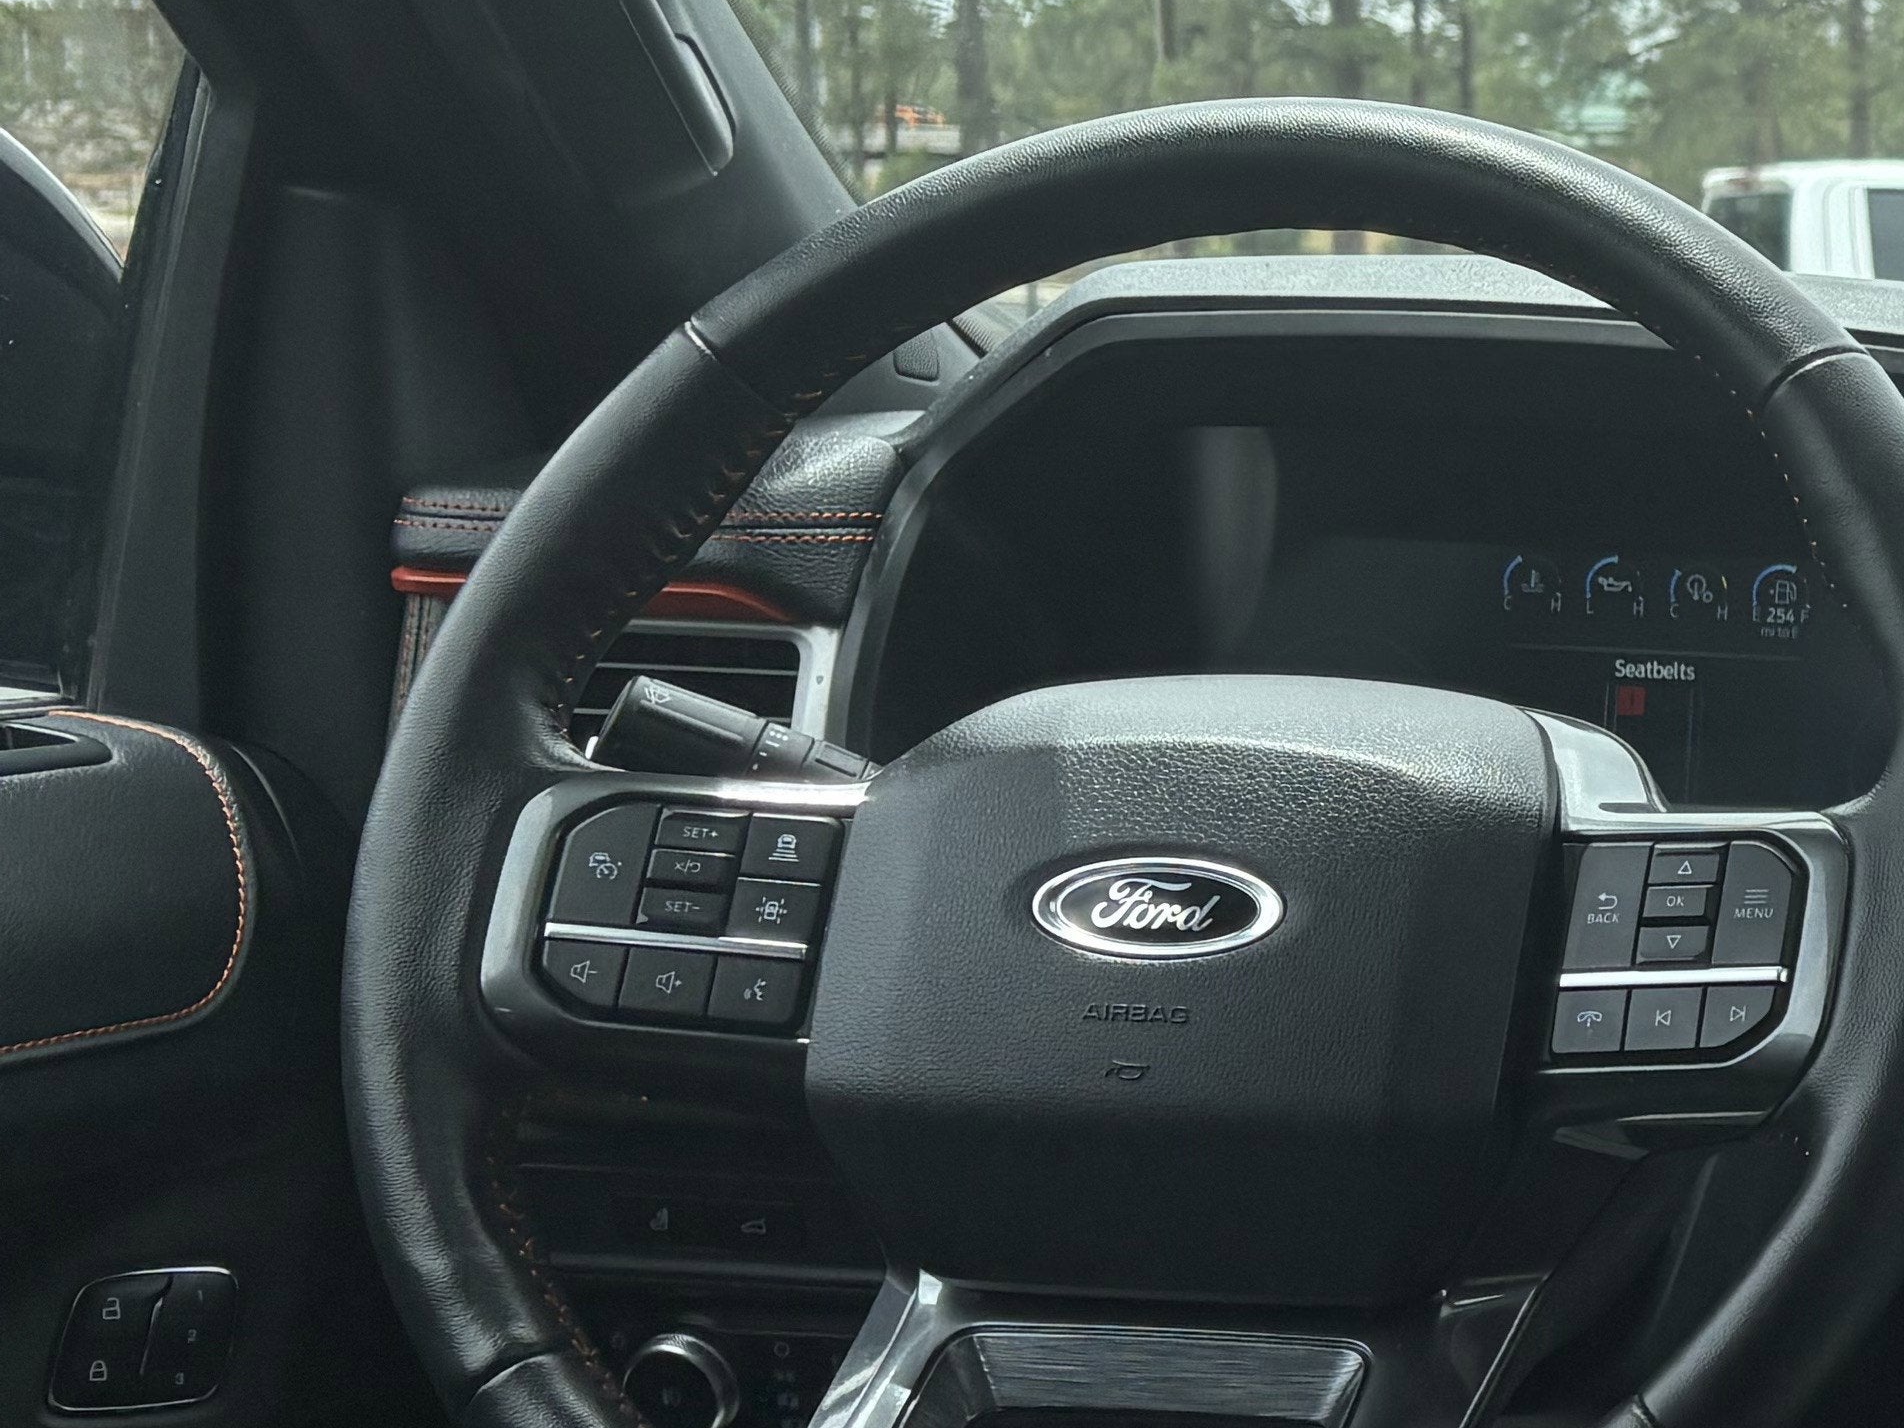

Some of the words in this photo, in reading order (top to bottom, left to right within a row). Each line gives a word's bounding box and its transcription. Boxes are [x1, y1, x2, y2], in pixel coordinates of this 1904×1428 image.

[1716, 604, 1729, 621] H
[1765, 606, 1796, 624] 254
[1614, 658, 1696, 682] Seatbelts
[682, 825, 719, 840] SET+
[1091, 877, 1221, 933] Ford
[1665, 894, 1686, 908] OK
[1586, 912, 1621, 925] BACK
[1733, 907, 1775, 920] MENU
[1081, 1002, 1190, 1024] AIRBAG
